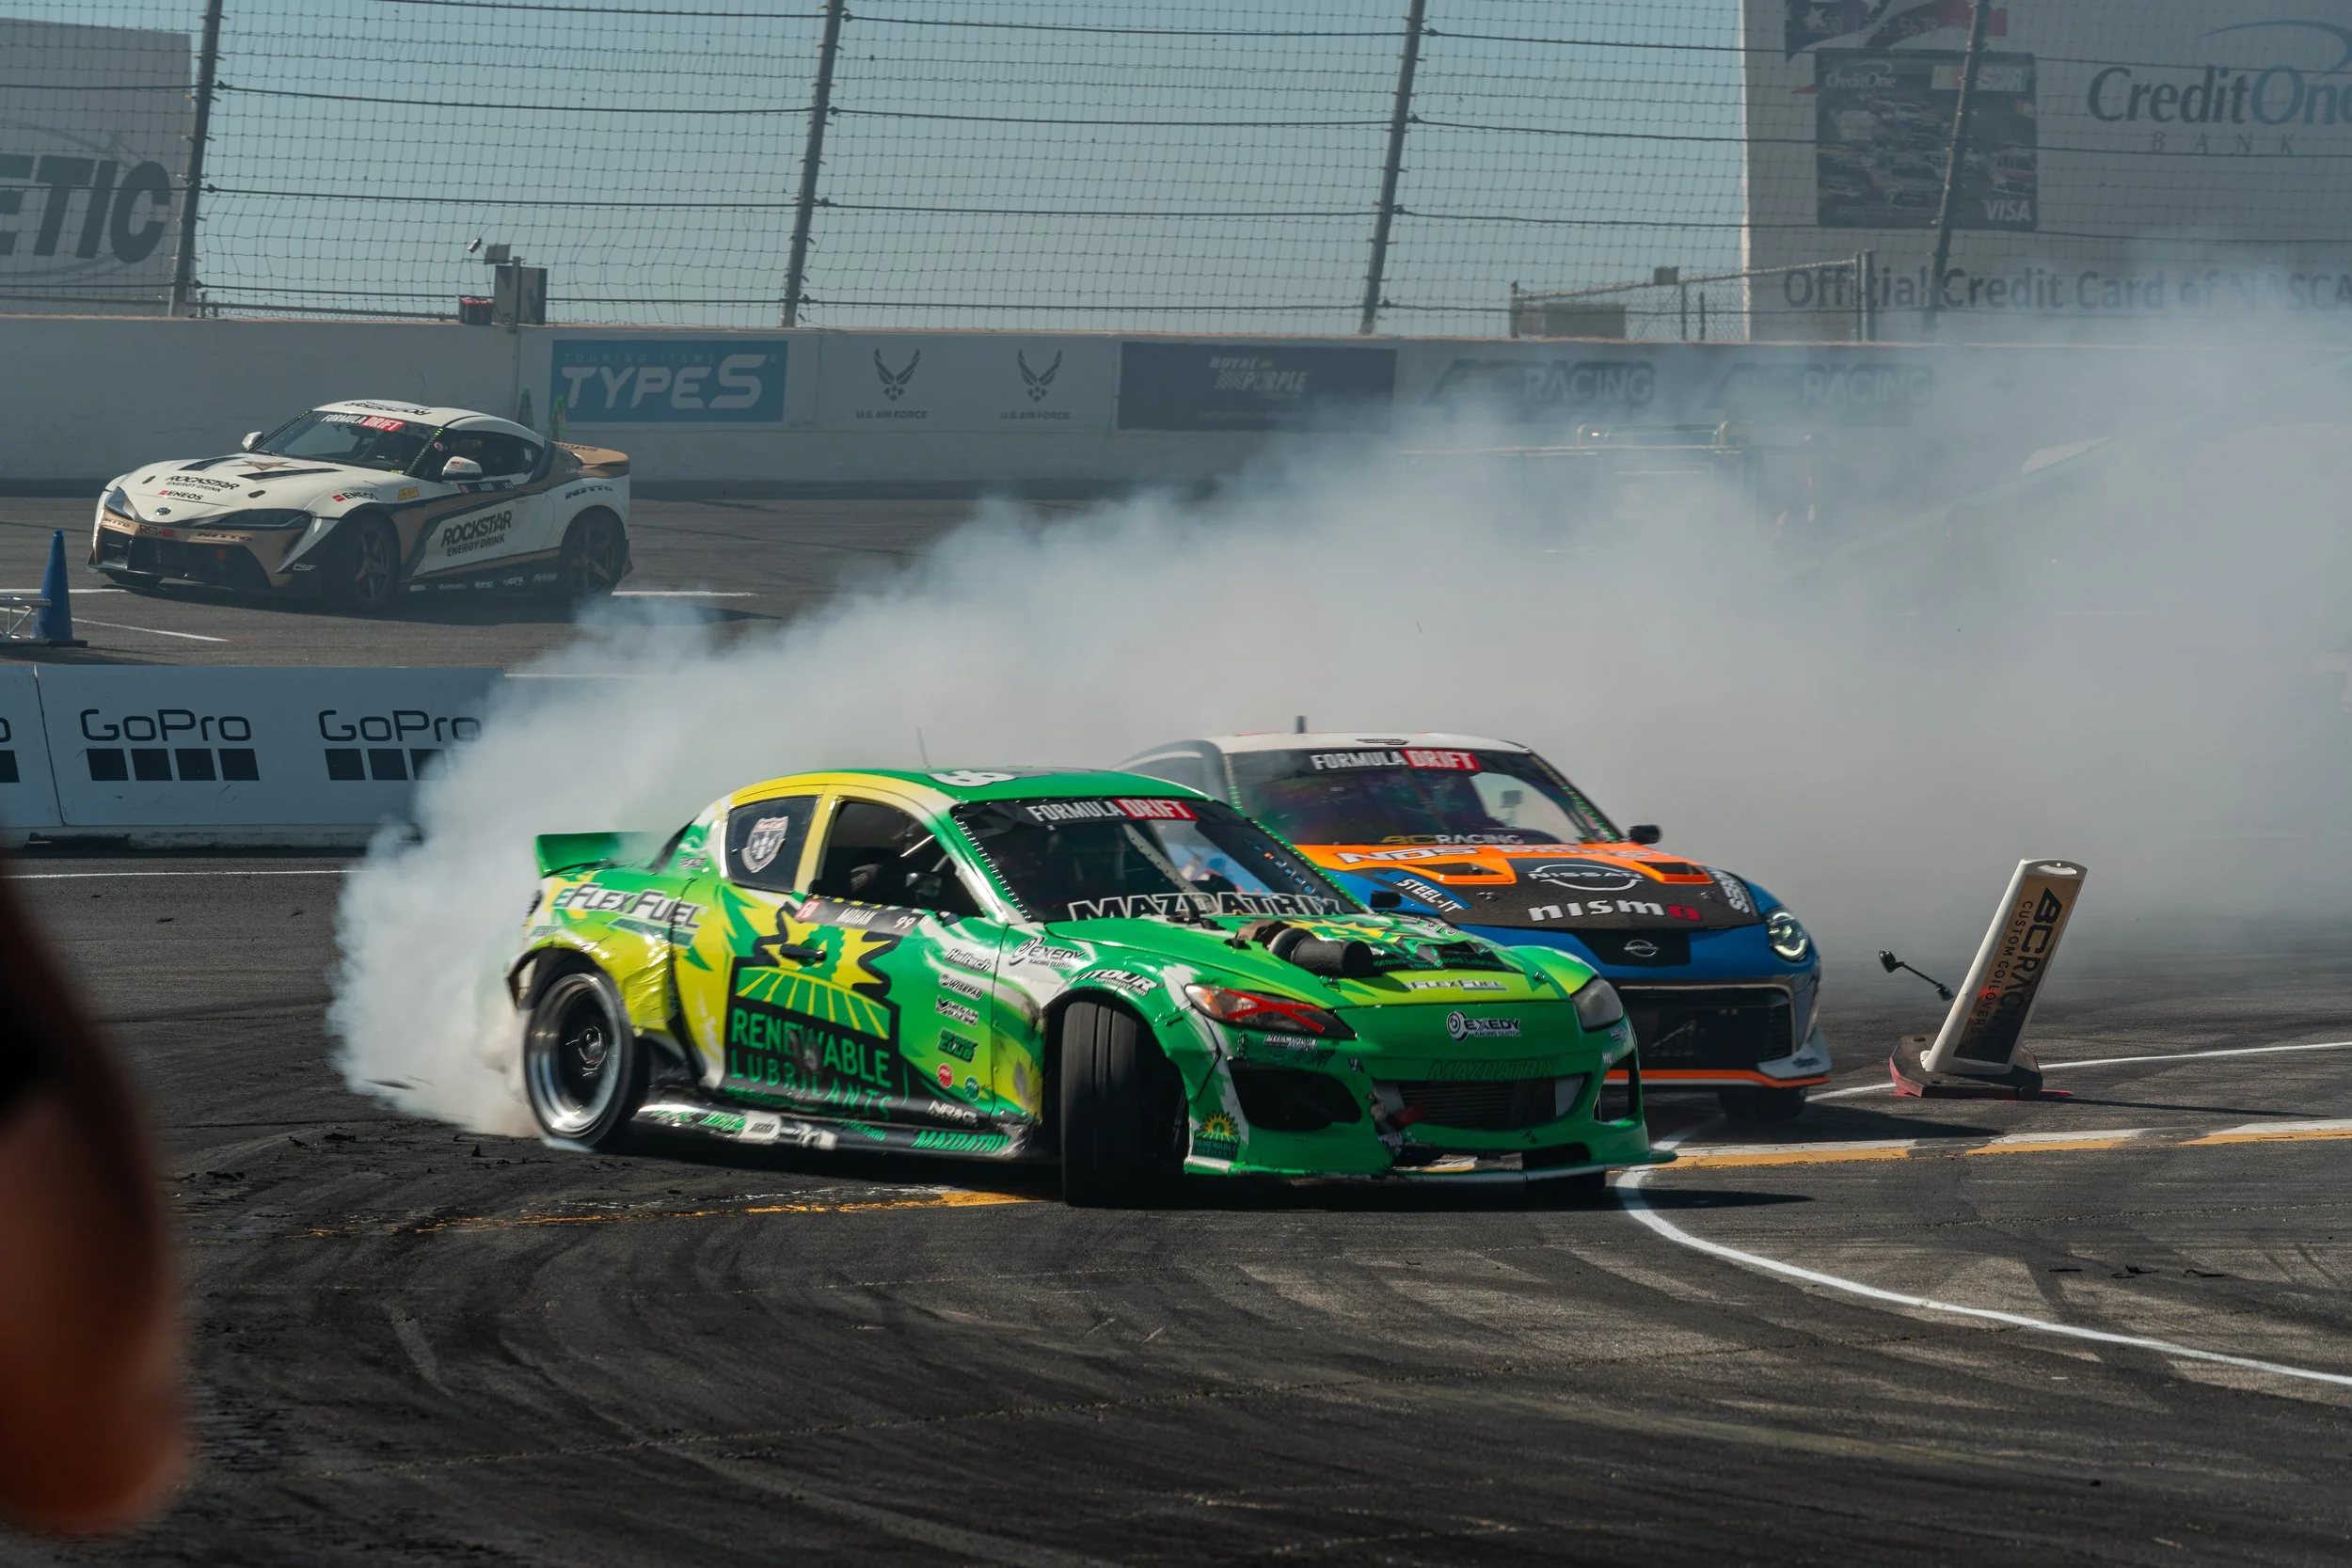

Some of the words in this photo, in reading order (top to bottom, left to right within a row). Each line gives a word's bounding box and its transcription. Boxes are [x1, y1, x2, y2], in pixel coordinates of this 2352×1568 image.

[1983, 199, 2032, 222] VISA
[1784, 264, 1929, 308] Offial
[1942, 267, 2064, 309] Credit
[2075, 270, 2164, 310] Card
[321, 414, 367, 425] FORMULA
[362, 417, 403, 432] DRIFT
[894, 410, 929, 420] FORCE
[1037, 411, 1071, 420] FORCE
[167, 491, 204, 501] ENEOS
[440, 510, 512, 547] ROCKSTAR
[447, 541, 480, 557] ENERGY
[480, 534, 505, 548] DRINK
[80, 709, 252, 742] GoPro
[318, 710, 482, 743] GoPro
[1311, 752, 1410, 770] FORMULA
[1404, 751, 1476, 769] DRIFT
[1025, 800, 1127, 822] FORMULA
[1115, 800, 1189, 819] DRIFT
[1396, 878, 1465, 912] STEEL-IT
[1067, 892, 1347, 923] MAZDATRIX
[894, 915, 916, 929] 99
[2004, 900, 2033, 958] CUSTOM
[944, 948, 992, 973] Haltech
[1026, 943, 1086, 960] EXEDY
[1464, 1019, 1520, 1031] EXEDY
